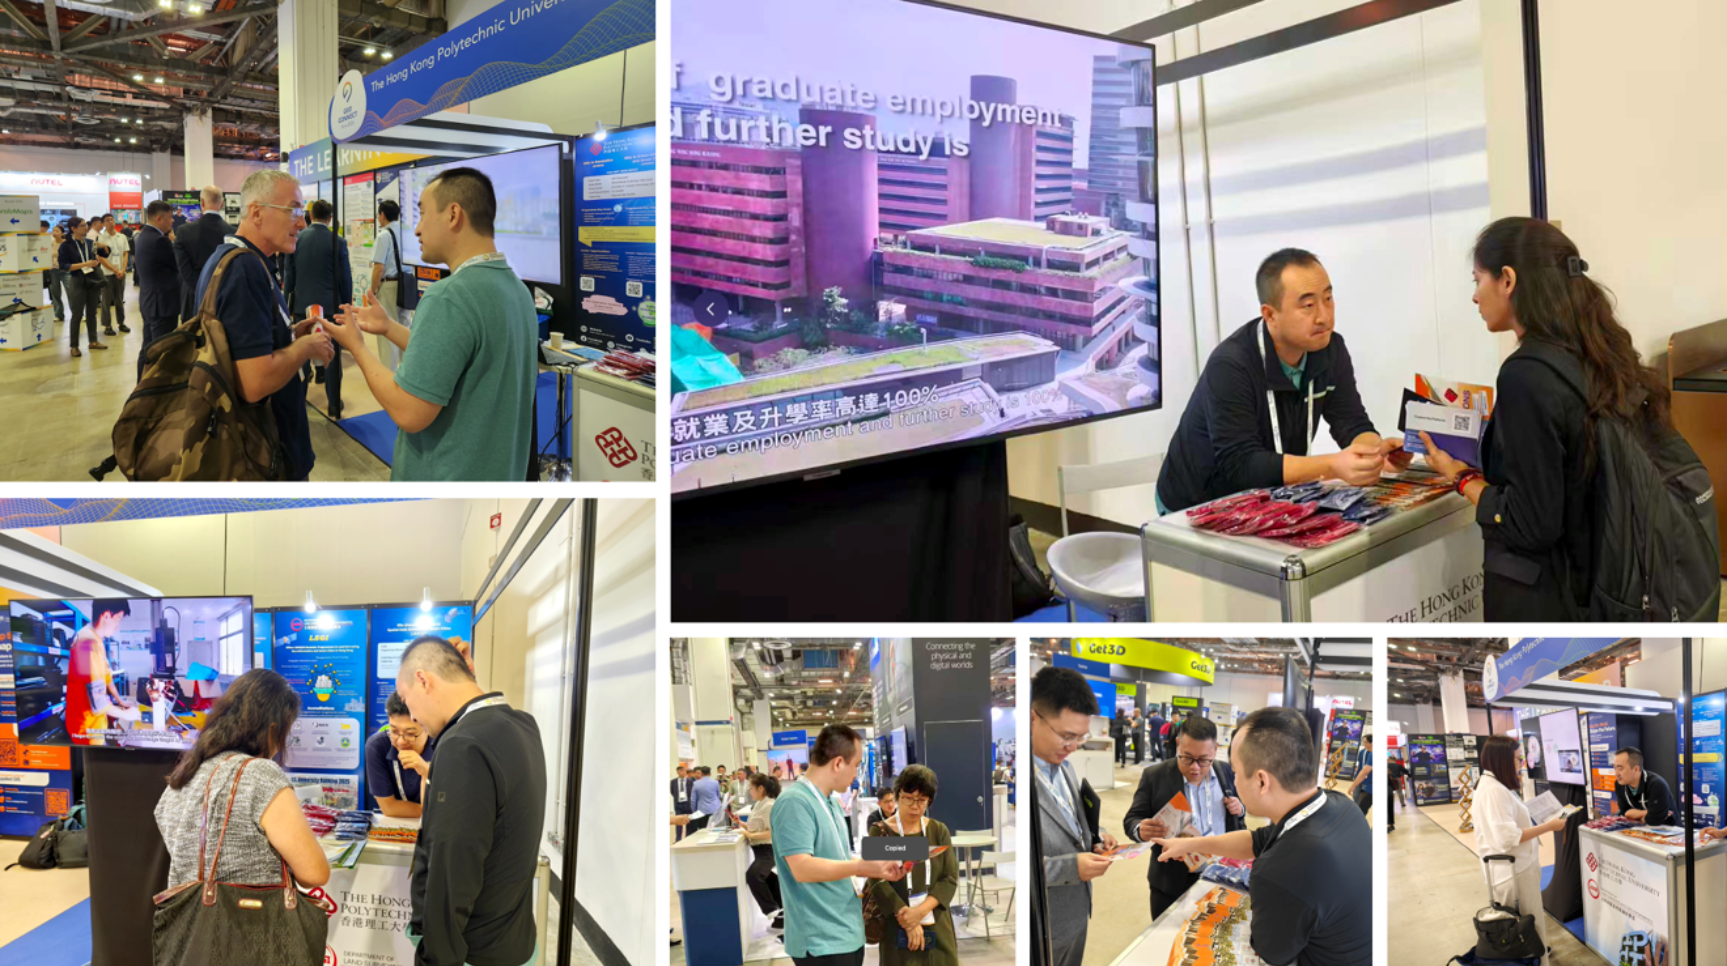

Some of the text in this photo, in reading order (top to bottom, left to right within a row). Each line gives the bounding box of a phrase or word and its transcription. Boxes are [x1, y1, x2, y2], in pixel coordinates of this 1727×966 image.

[371, 0, 566, 92] The Hong Kong Polytechnic Unive
[708, 72, 877, 109] graduate
[886, 93, 1062, 128] employment
[696, 109, 833, 148] further
[843, 119, 936, 160] study
[944, 132, 970, 157] is
[293, 156, 313, 178] THE
[671, 385, 939, 443] 就業及升學率高達100%
[726, 421, 853, 453] employment
[859, 414, 893, 434] and
[899, 405, 955, 427] further
[960, 397, 1000, 417] study
[1420, 585, 1460, 618] HONG
[925, 642, 976, 652] Connecting the
[930, 651, 972, 661] physical and
[1089, 643, 1127, 656] Get3D
[930, 661, 973, 671] digital worlds
[340, 890, 411, 908] THE HONG
[343, 950, 385, 961] DEPARTMENT
[343, 958, 363, 966] LAND
